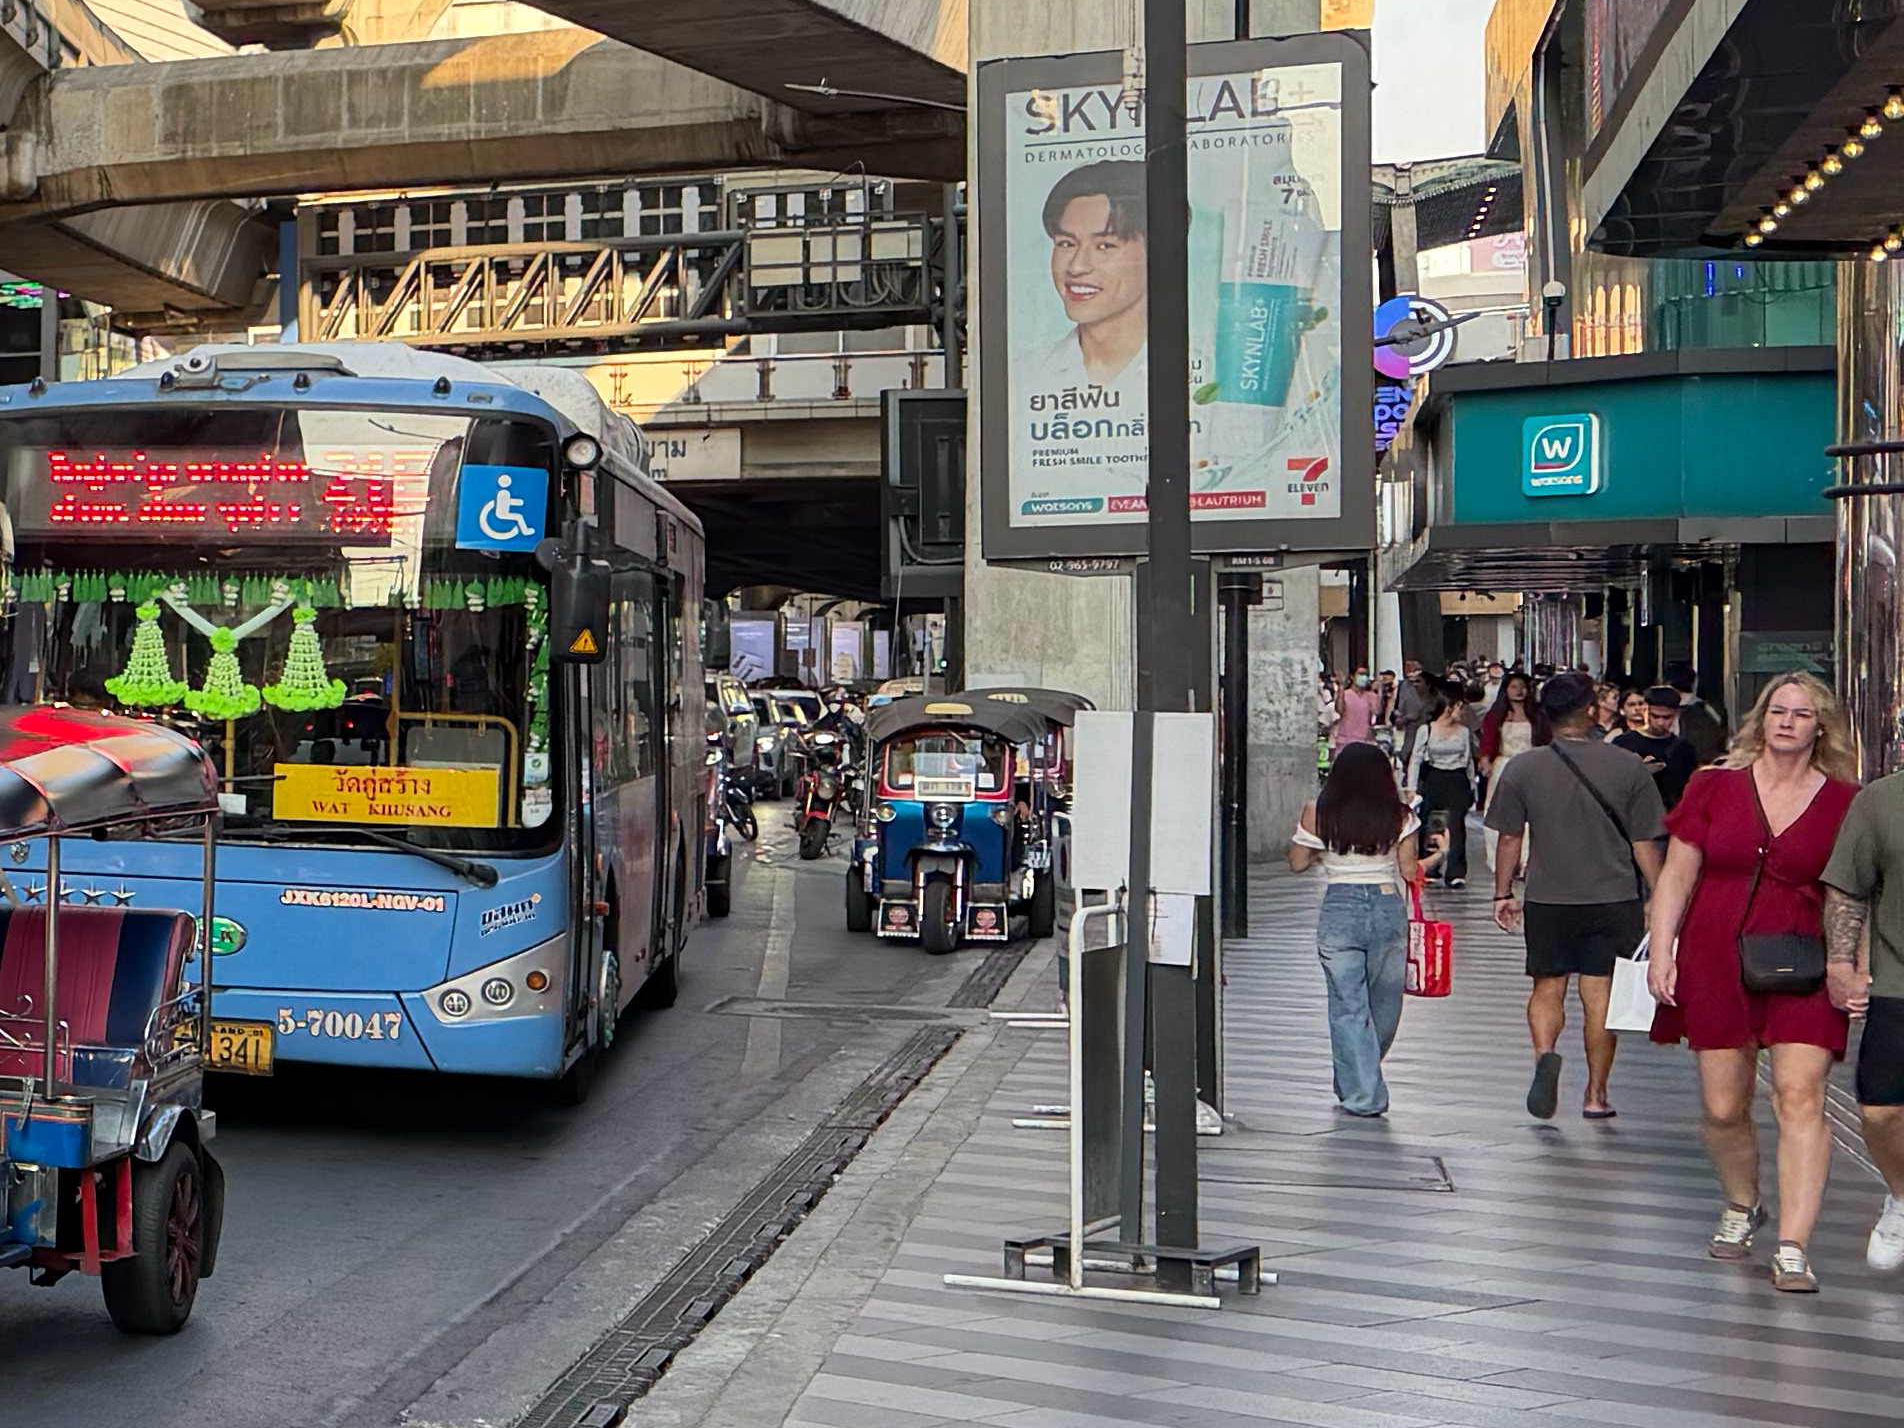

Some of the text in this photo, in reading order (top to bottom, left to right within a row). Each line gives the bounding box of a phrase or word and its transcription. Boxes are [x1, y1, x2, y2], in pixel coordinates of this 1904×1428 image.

[1025, 144, 1145, 164] DERMATOLOG
[1030, 384, 1120, 411] ยาสีฟัน
[1031, 499, 1093, 512] watsons
[1110, 498, 1148, 510] EVEAN
[312, 800, 350, 815] WAT
[278, 1007, 402, 1040] 5-70047
[219, 1036, 260, 1067] 341
